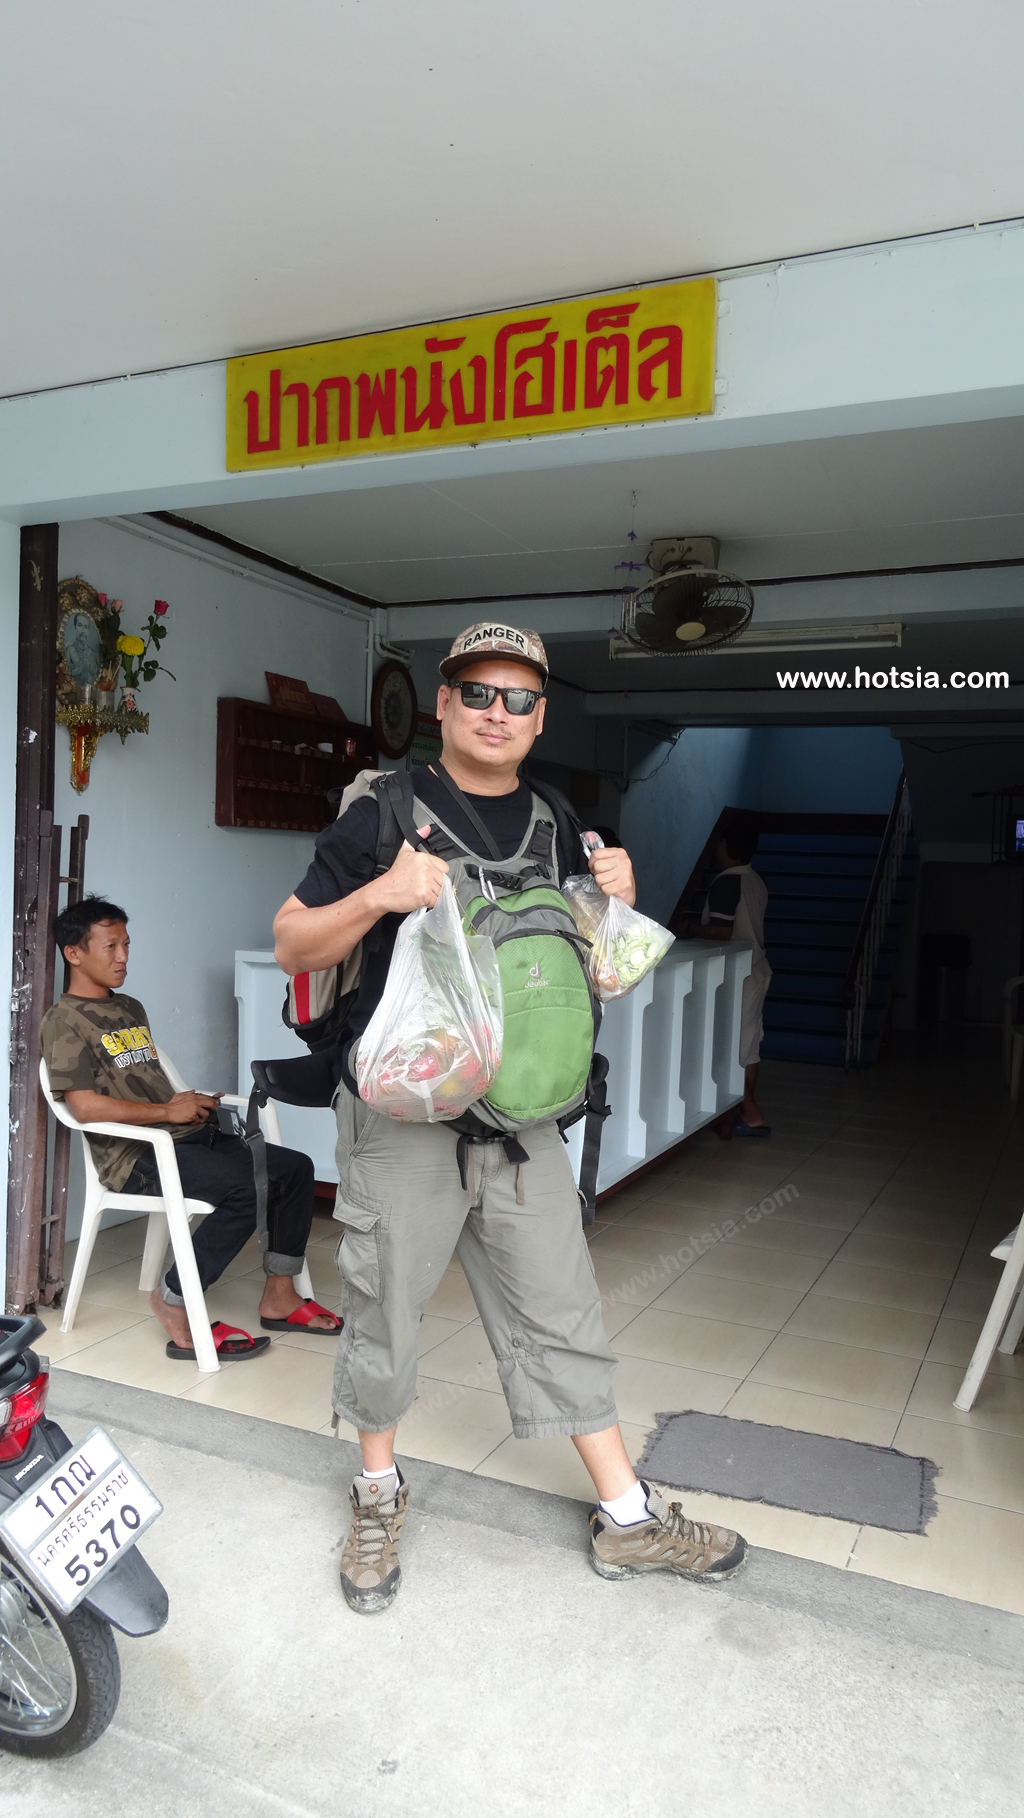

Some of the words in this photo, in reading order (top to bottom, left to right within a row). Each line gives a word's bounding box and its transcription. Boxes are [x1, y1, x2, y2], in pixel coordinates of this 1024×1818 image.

[243, 302, 683, 455] ปากพนังโฮเต็ล
[463, 627, 525, 650] RANGER
[38, 1469, 129, 1567] นครศรีธรรมราช
[65, 1504, 141, 1587] 5370
